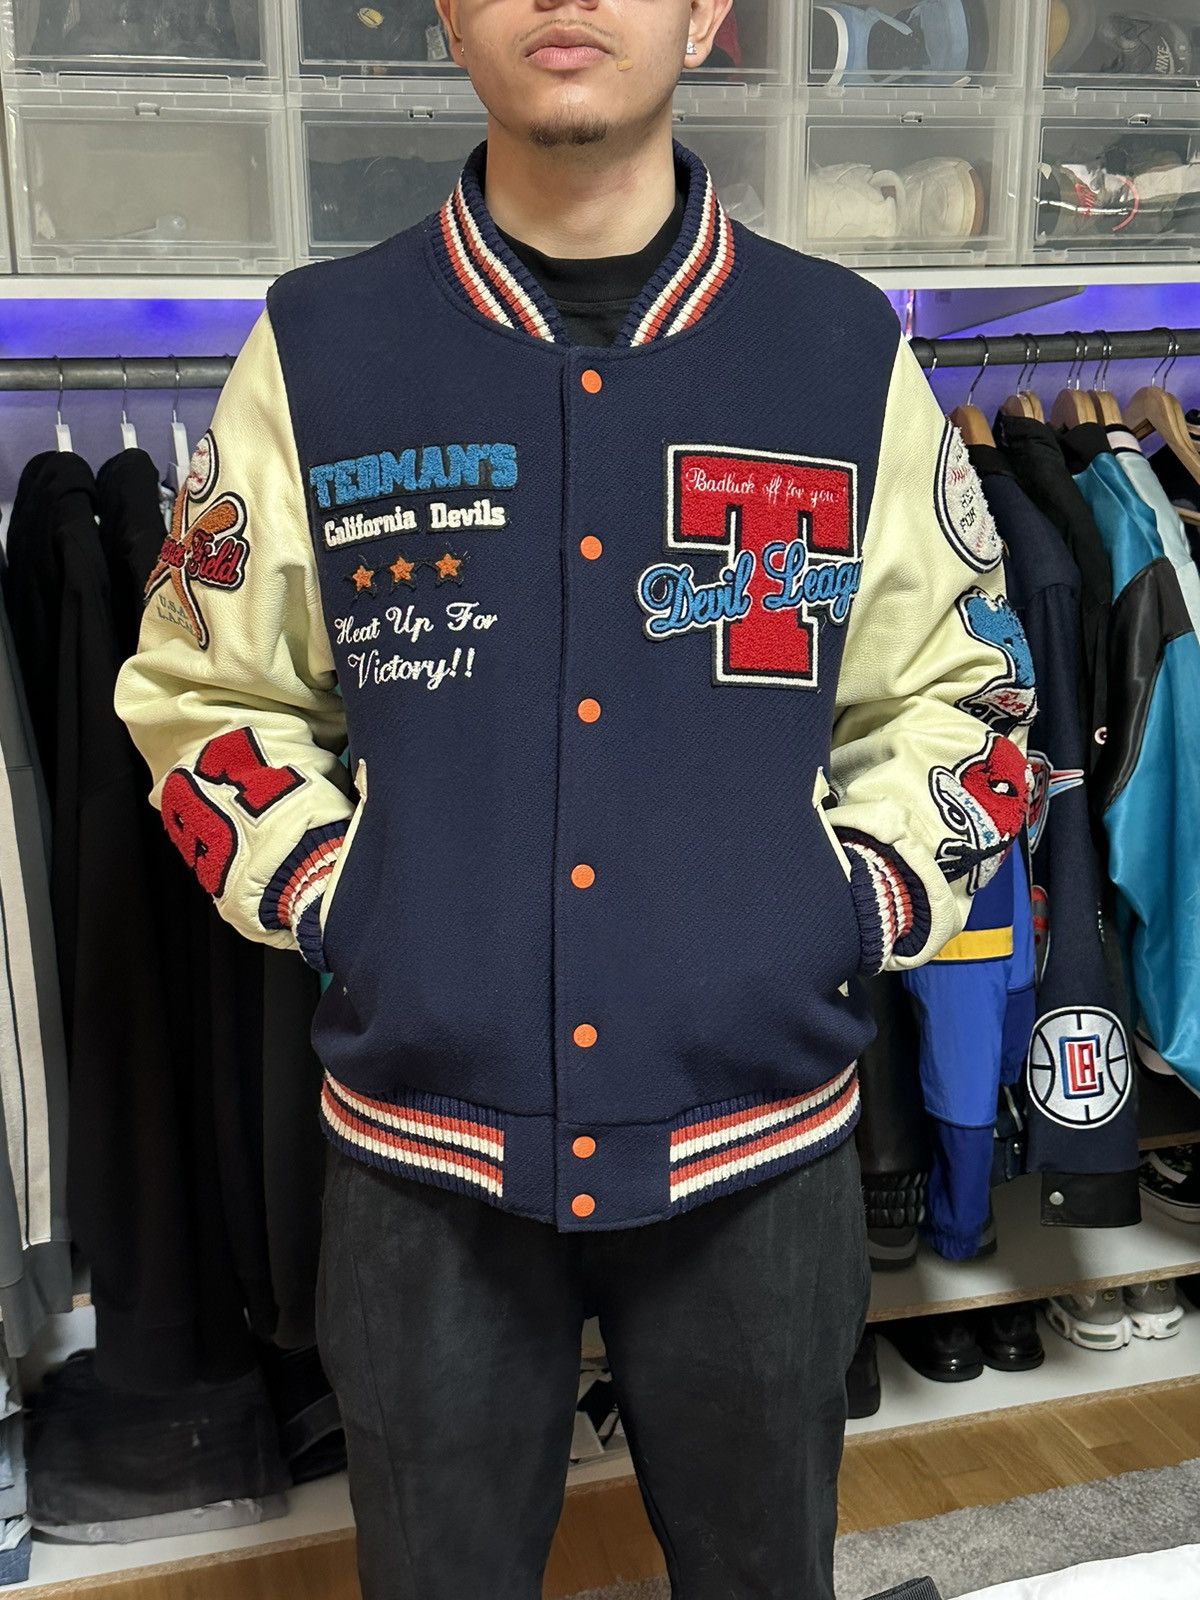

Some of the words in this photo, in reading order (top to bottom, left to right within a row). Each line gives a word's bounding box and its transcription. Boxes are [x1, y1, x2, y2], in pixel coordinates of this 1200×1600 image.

[1154, 45, 1169, 74] NIKE
[309, 443, 518, 509] TEDMAN'S
[686, 467, 756, 494] Badluck
[324, 505, 418, 547] California
[429, 499, 507, 530] Devils
[639, 549, 755, 636] Devil
[334, 615, 382, 645] Heat
[385, 605, 434, 643] Up
[446, 601, 499, 632] For
[347, 647, 476, 690] Victory!!
